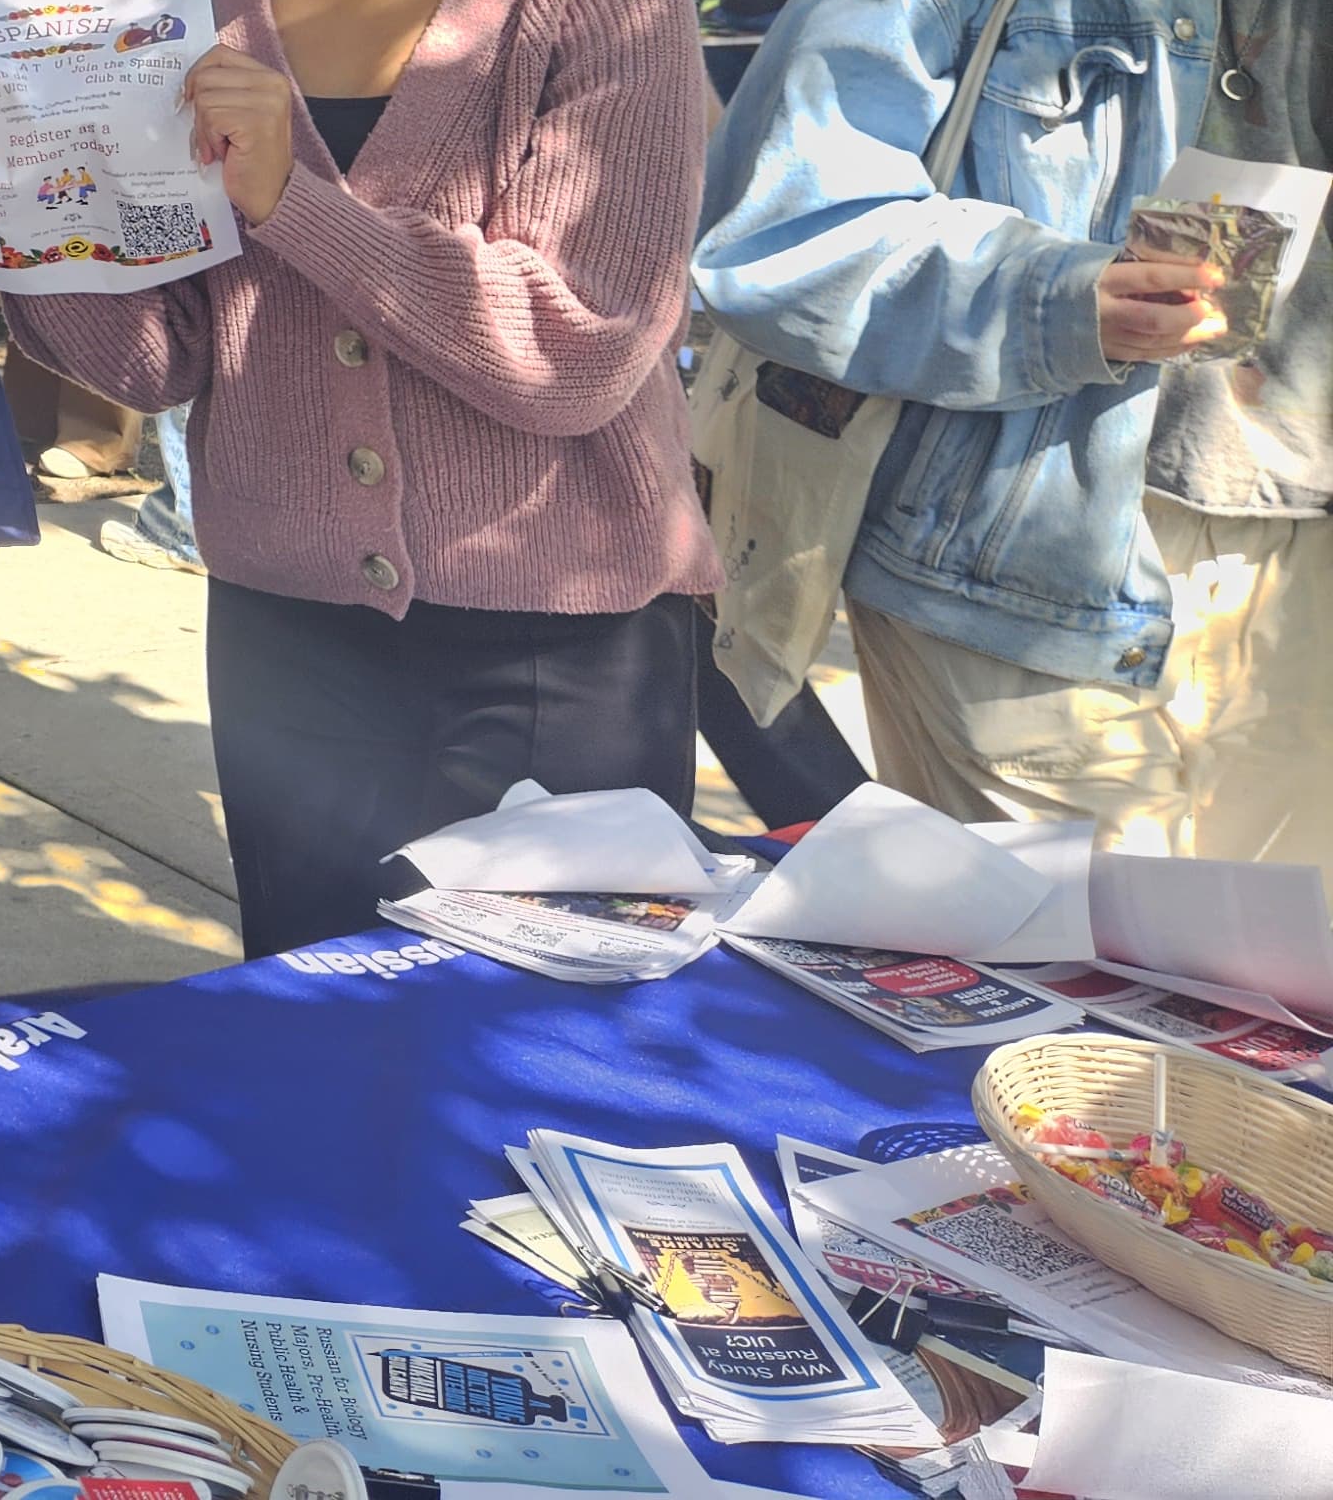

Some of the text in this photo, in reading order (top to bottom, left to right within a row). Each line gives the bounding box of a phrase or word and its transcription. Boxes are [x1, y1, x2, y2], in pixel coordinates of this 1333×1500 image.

[54, 54, 86, 69] UIC
[71, 57, 182, 74] Join the Spanish
[85, 73, 165, 86] Club at UIC!
[9, 123, 111, 148] Register as a
[6, 140, 120, 169] Member Today!
[276, 939, 466, 980] ussian
[952, 984, 998, 999] EVENTS
[961, 988, 1010, 1006] CULTURE
[977, 996, 1036, 1017] LANGUAGE
[1222, 1185, 1277, 1220] JOLLY
[826, 1254, 961, 1294] CREDITS
[700, 1345, 818, 1363] Russian at
[725, 1334, 777, 1348] UIC?
[240, 1319, 283, 1422] Nursing Students
[265, 1321, 310, 1415] Public Health &
[291, 1324, 343, 1438] Majors, Pre-Health,
[409, 1355, 436, 1403] MIKHAIL
[707, 1359, 832, 1380] Why Study
[316, 1327, 367, 1440] Russian for Biology
[444, 1361, 467, 1413] NOTEBOOK
[466, 1368, 492, 1416] DOCTOR'S
[491, 1376, 526, 1423] YOUNG
[529, 1400, 551, 1408] A
